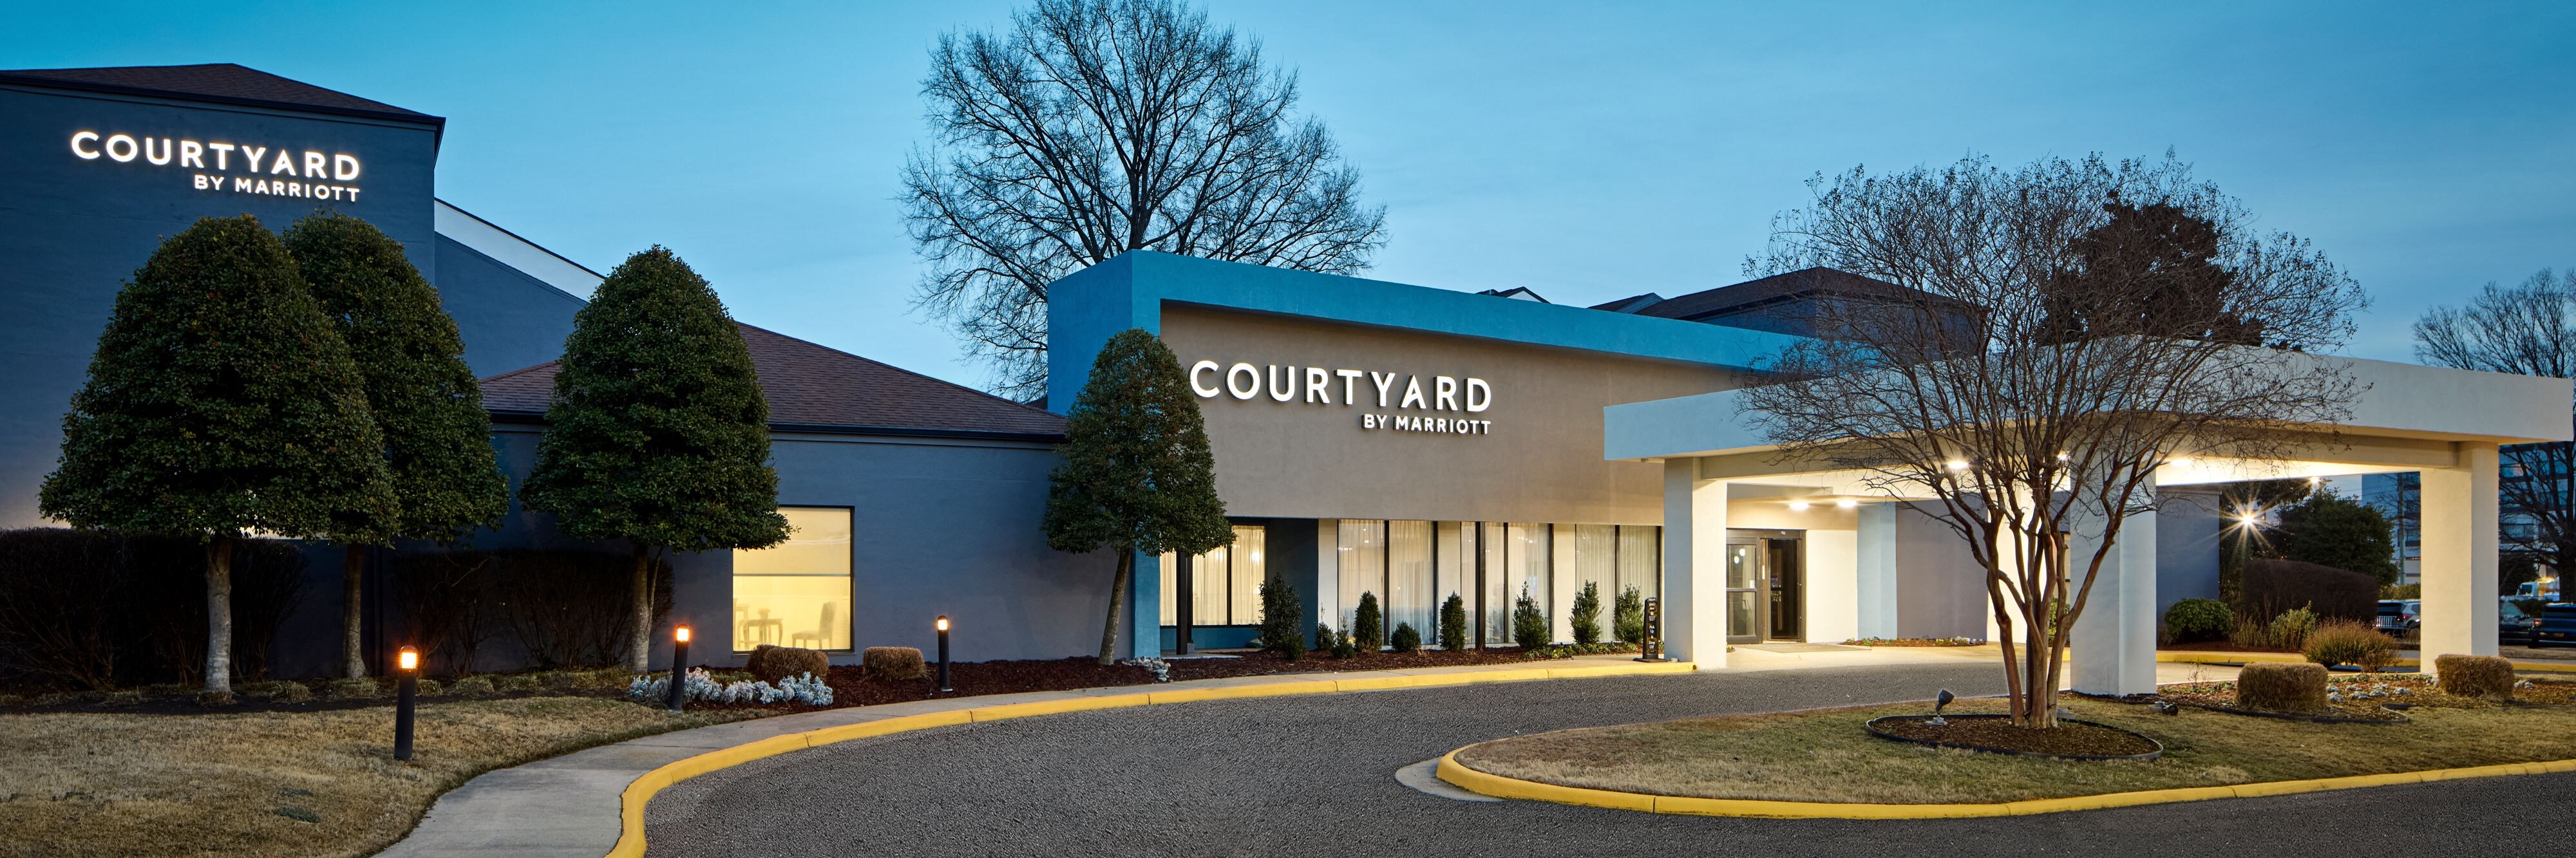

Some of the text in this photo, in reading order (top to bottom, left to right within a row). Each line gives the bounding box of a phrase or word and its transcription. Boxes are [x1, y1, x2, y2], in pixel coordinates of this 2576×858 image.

[71, 131, 360, 181] COURTYARD
[194, 174, 359, 202] BY MARRIOTT
[1190, 360, 1492, 412] COURTYARD
[1363, 414, 1491, 434] BY MARRIOTT
